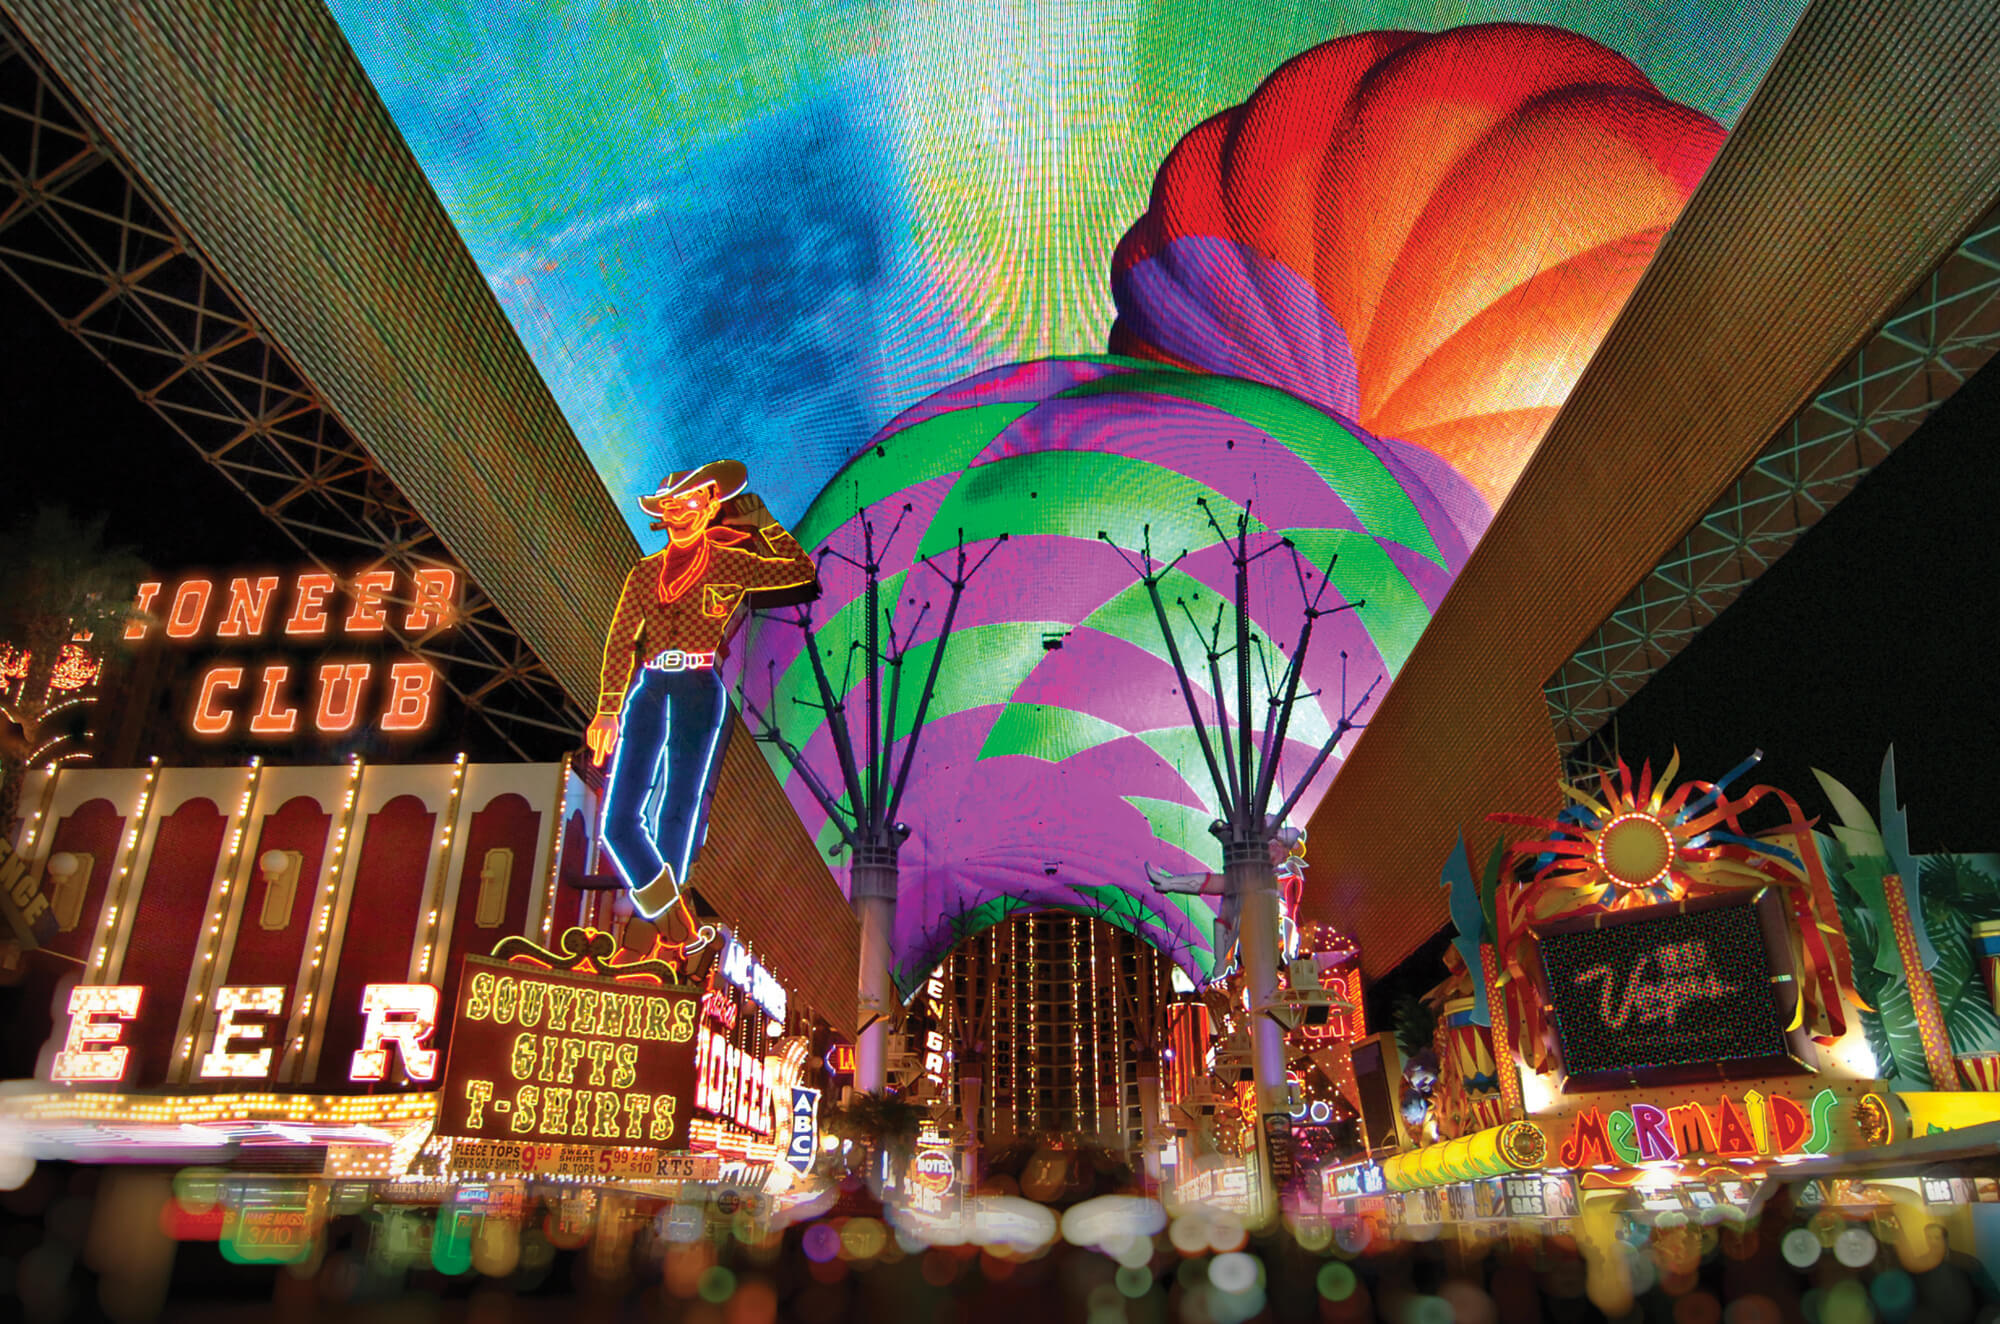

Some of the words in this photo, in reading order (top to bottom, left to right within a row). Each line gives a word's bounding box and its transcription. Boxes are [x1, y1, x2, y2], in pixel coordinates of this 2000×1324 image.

[72, 569, 458, 641] IONEER
[193, 663, 434, 734] CLUB
[466, 972, 697, 1043] SOUVENIRS
[511, 1032, 638, 1089] GIFTS
[465, 1079, 677, 1140] T-SHIRTS
[791, 1093, 813, 1154] ABC
[454, 1143, 489, 1157] FLEECE
[489, 1144, 521, 1159] TOPS
[558, 1155, 595, 1163] SHIRTS
[560, 1148, 595, 1157] SWEAT
[631, 1153, 639, 1161] 2
[640, 1153, 654, 1162] for
[475, 1158, 494, 1170] GOLF
[494, 1159, 520, 1171] SHIRTS
[575, 1163, 595, 1175] TOPS
[630, 1161, 651, 1174] $10
[656, 1158, 694, 1177] RTS
[1506, 1179, 1543, 1197] FREE
[1510, 1197, 1543, 1215] GAS
